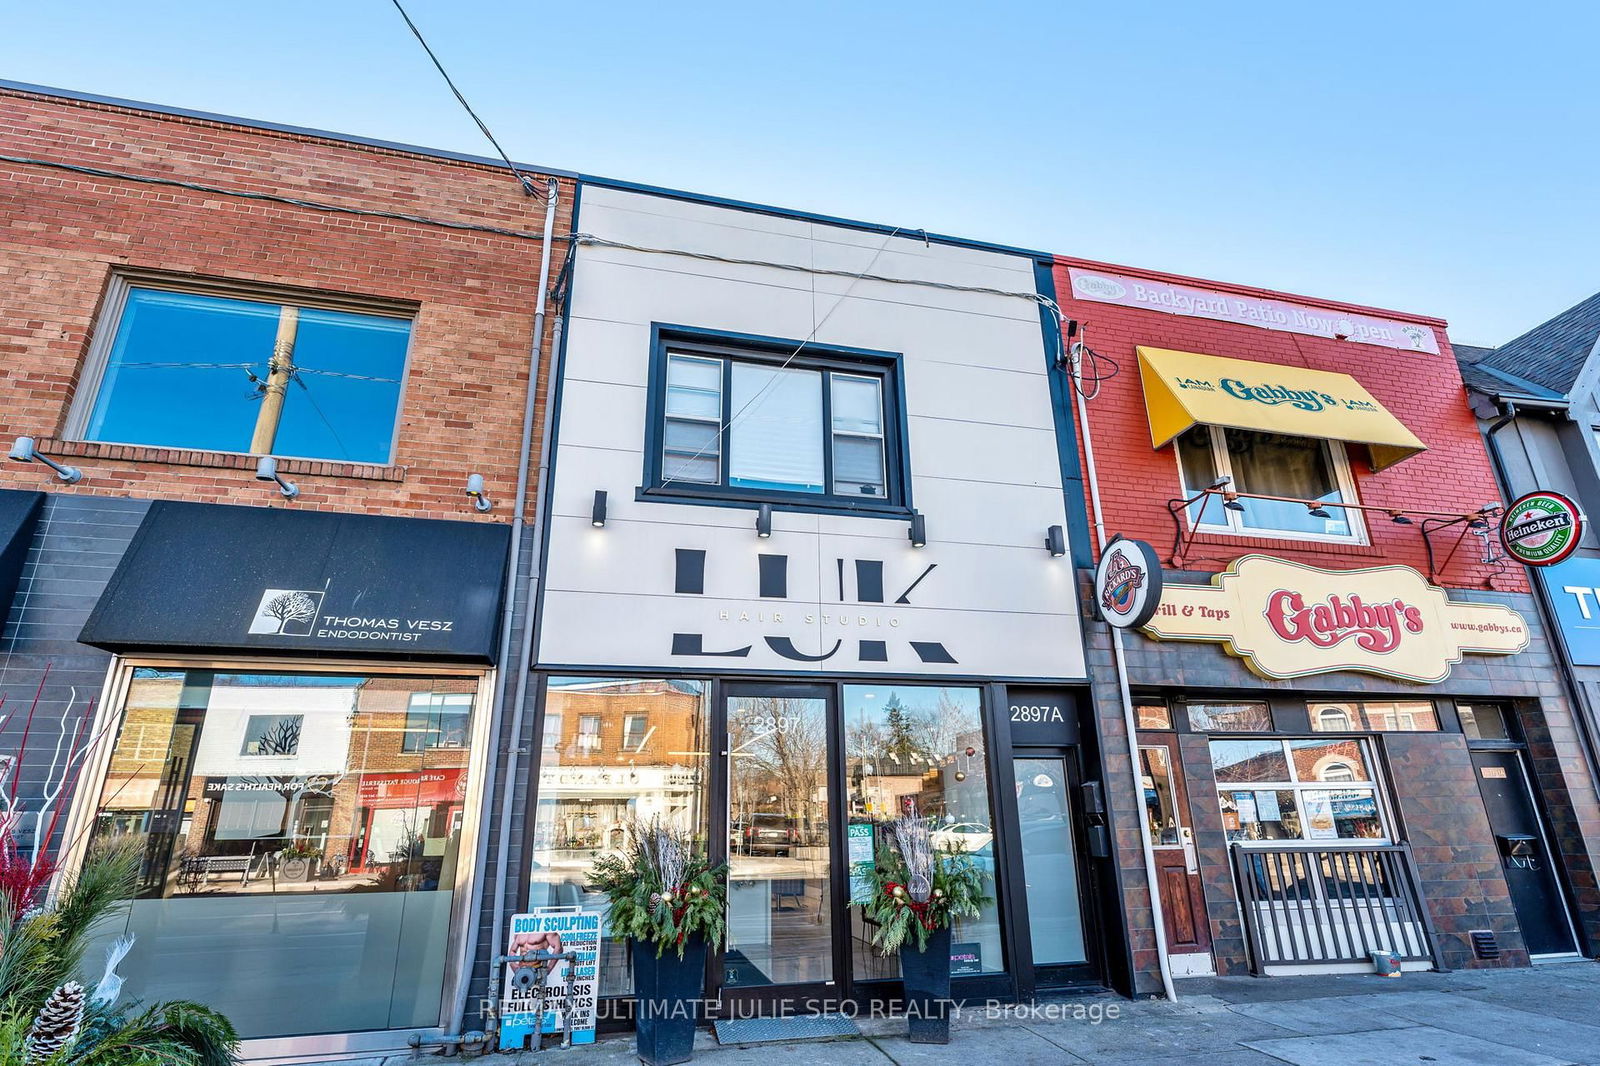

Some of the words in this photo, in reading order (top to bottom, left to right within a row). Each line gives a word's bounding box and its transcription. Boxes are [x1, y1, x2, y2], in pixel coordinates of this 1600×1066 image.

[1133, 284, 1232, 314] Backyard
[1235, 301, 1288, 325] Patio
[1292, 309, 1335, 334] Now
[1218, 376, 1338, 413] Gabby's
[1536, 499, 1556, 510] BEER
[1506, 515, 1566, 542] Heineken
[1515, 545, 1544, 557] PREMIUM
[1542, 534, 1565, 555] QUALITY
[1103, 568, 1138, 600] RICKARD'S
[719, 609, 783, 623] HAIR
[804, 613, 902, 628] STUDIO
[1155, 603, 1178, 617] rill
[1181, 605, 1194, 617] &
[1198, 605, 1231, 621] Taps
[323, 615, 400, 629] THOMAS
[407, 619, 454, 631] VESZ
[1262, 588, 1425, 655] Gabby's
[1450, 620, 1523, 634] www.gabbys.ca
[317, 629, 422, 642] ENDODONTIST
[1010, 705, 1065, 723] 2897A
[753, 716, 801, 734] 2897
[850, 828, 869, 837] PASS
[908, 883, 928, 894] hello
[514, 917, 542, 933] BODY
[543, 915, 599, 932] SCULPTING
[575, 966, 596, 976] LASER
[511, 984, 591, 1000] ELECROLSIS
[540, 997, 593, 1011] STHICS
[561, 1010, 579, 1019] WLK
